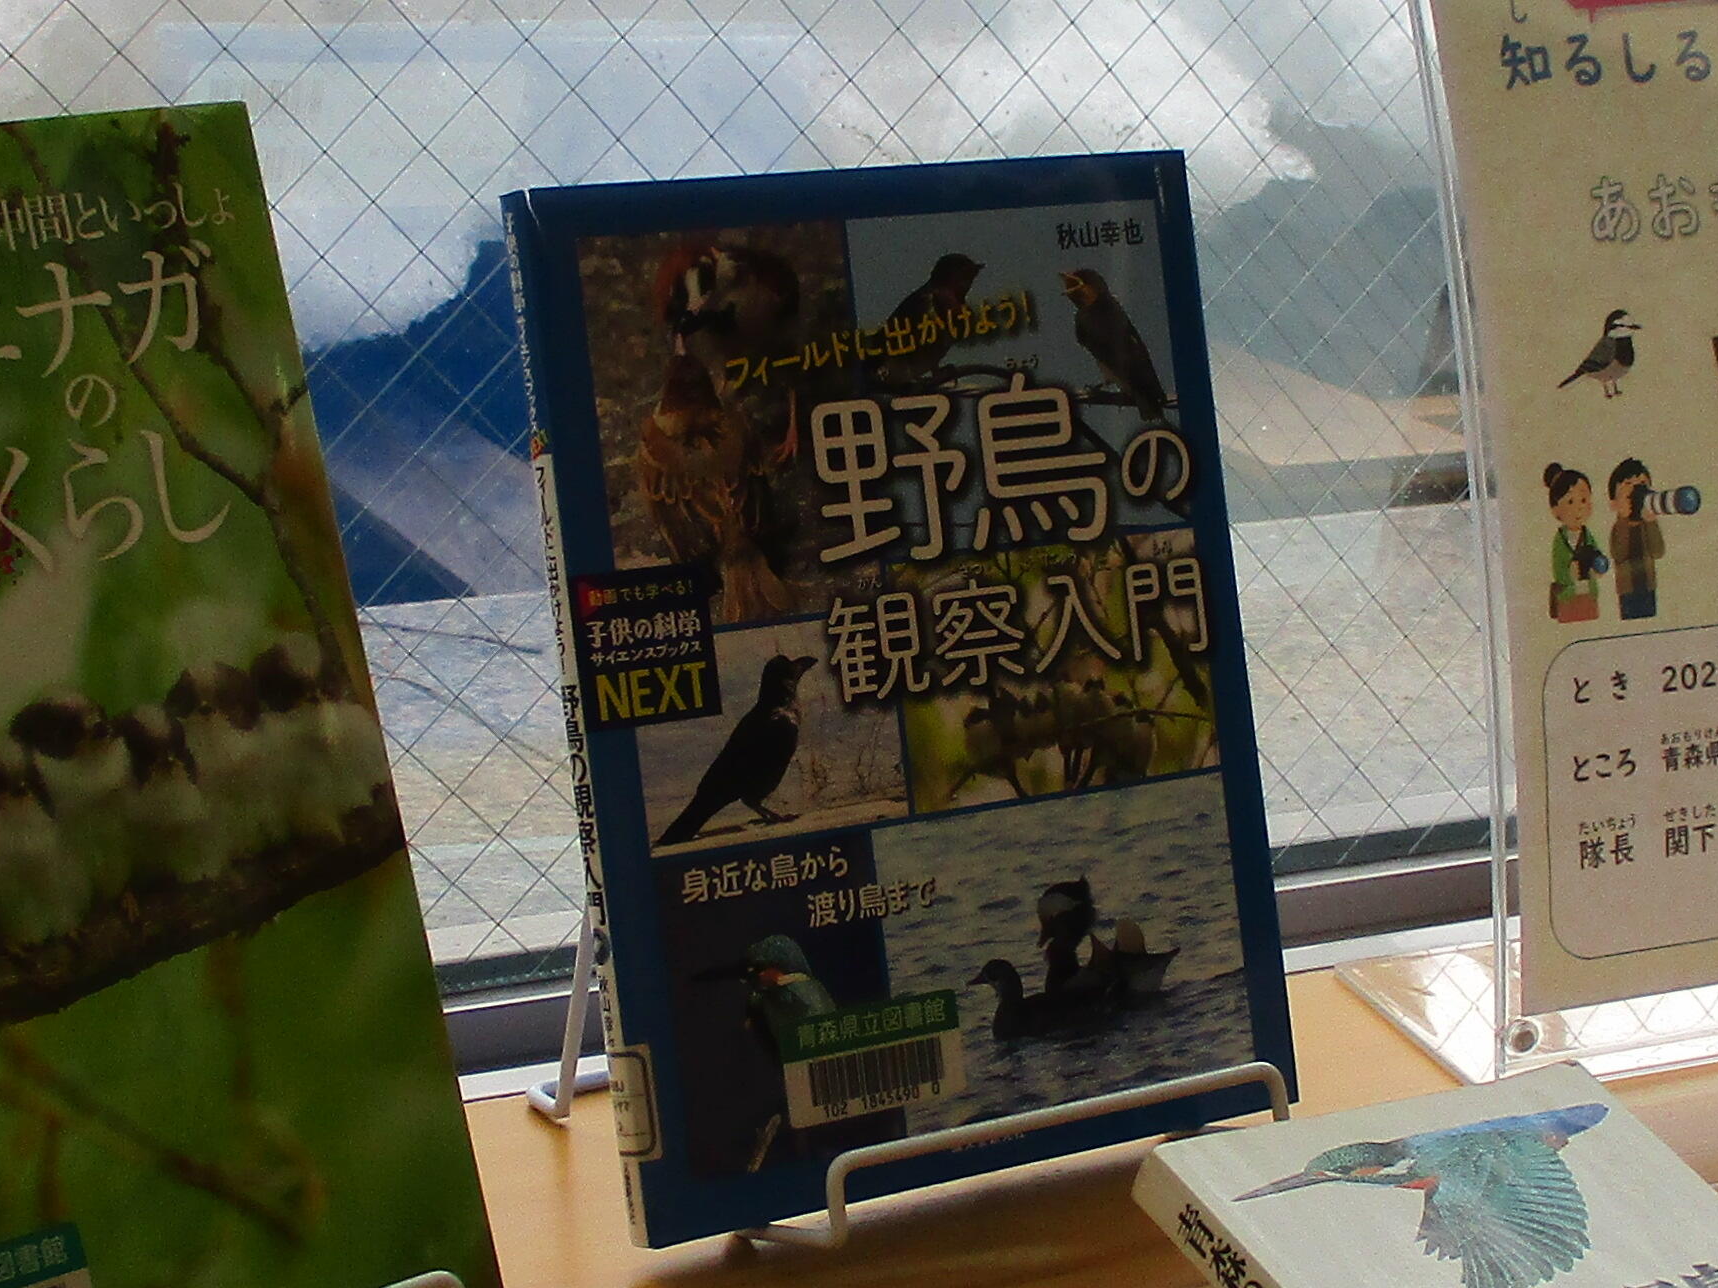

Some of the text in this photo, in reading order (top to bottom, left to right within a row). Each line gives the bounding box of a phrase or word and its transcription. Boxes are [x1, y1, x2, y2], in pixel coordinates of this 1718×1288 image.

[1056, 218, 1145, 250] 秋山幸也
[725, 290, 1033, 390] フィールドに出かけよう！
[64, 372, 117, 429] の
[809, 371, 1191, 565] 野鳥の
[585, 608, 703, 649] 子供の科学
[589, 640, 703, 668] サイエンスブックス
[826, 557, 1211, 704] 観察入門
[595, 660, 707, 722] NEXT
[1573, 748, 1638, 783] ところ
[1579, 833, 1635, 871] 隊長
[1665, 822, 1717, 859] 関下
[680, 845, 849, 905] 身近な鳥から
[807, 876, 937, 929] 渡り鳥まで
[796, 997, 946, 1049] 青森県立図書館
